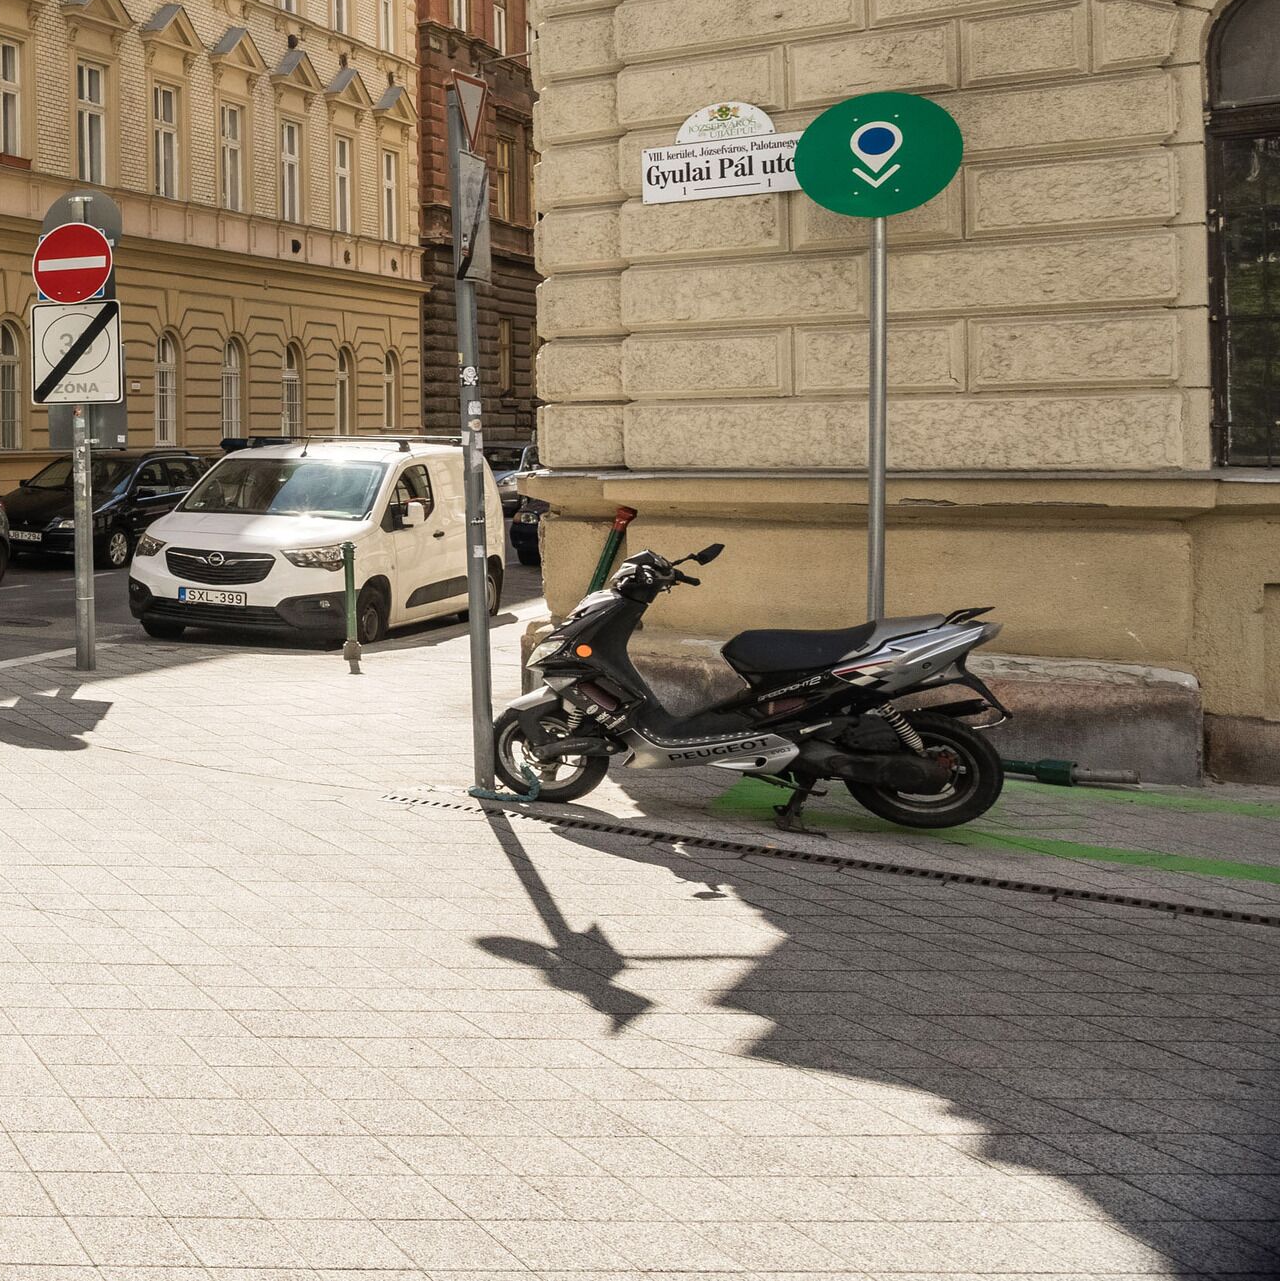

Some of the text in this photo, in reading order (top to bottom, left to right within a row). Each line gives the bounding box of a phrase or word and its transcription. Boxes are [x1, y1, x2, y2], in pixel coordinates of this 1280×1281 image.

[666, 149, 697, 160] kerület,
[699, 143, 749, 157] Józsefváros,
[750, 138, 798, 151] Palotanegy
[646, 152, 795, 189] Gyulai Pál utc
[59, 333, 93, 356] 3
[53, 381, 99, 394] ZÓNA
[188, 589, 243, 605] SXL-399
[667, 737, 770, 762] PEUGEOT
